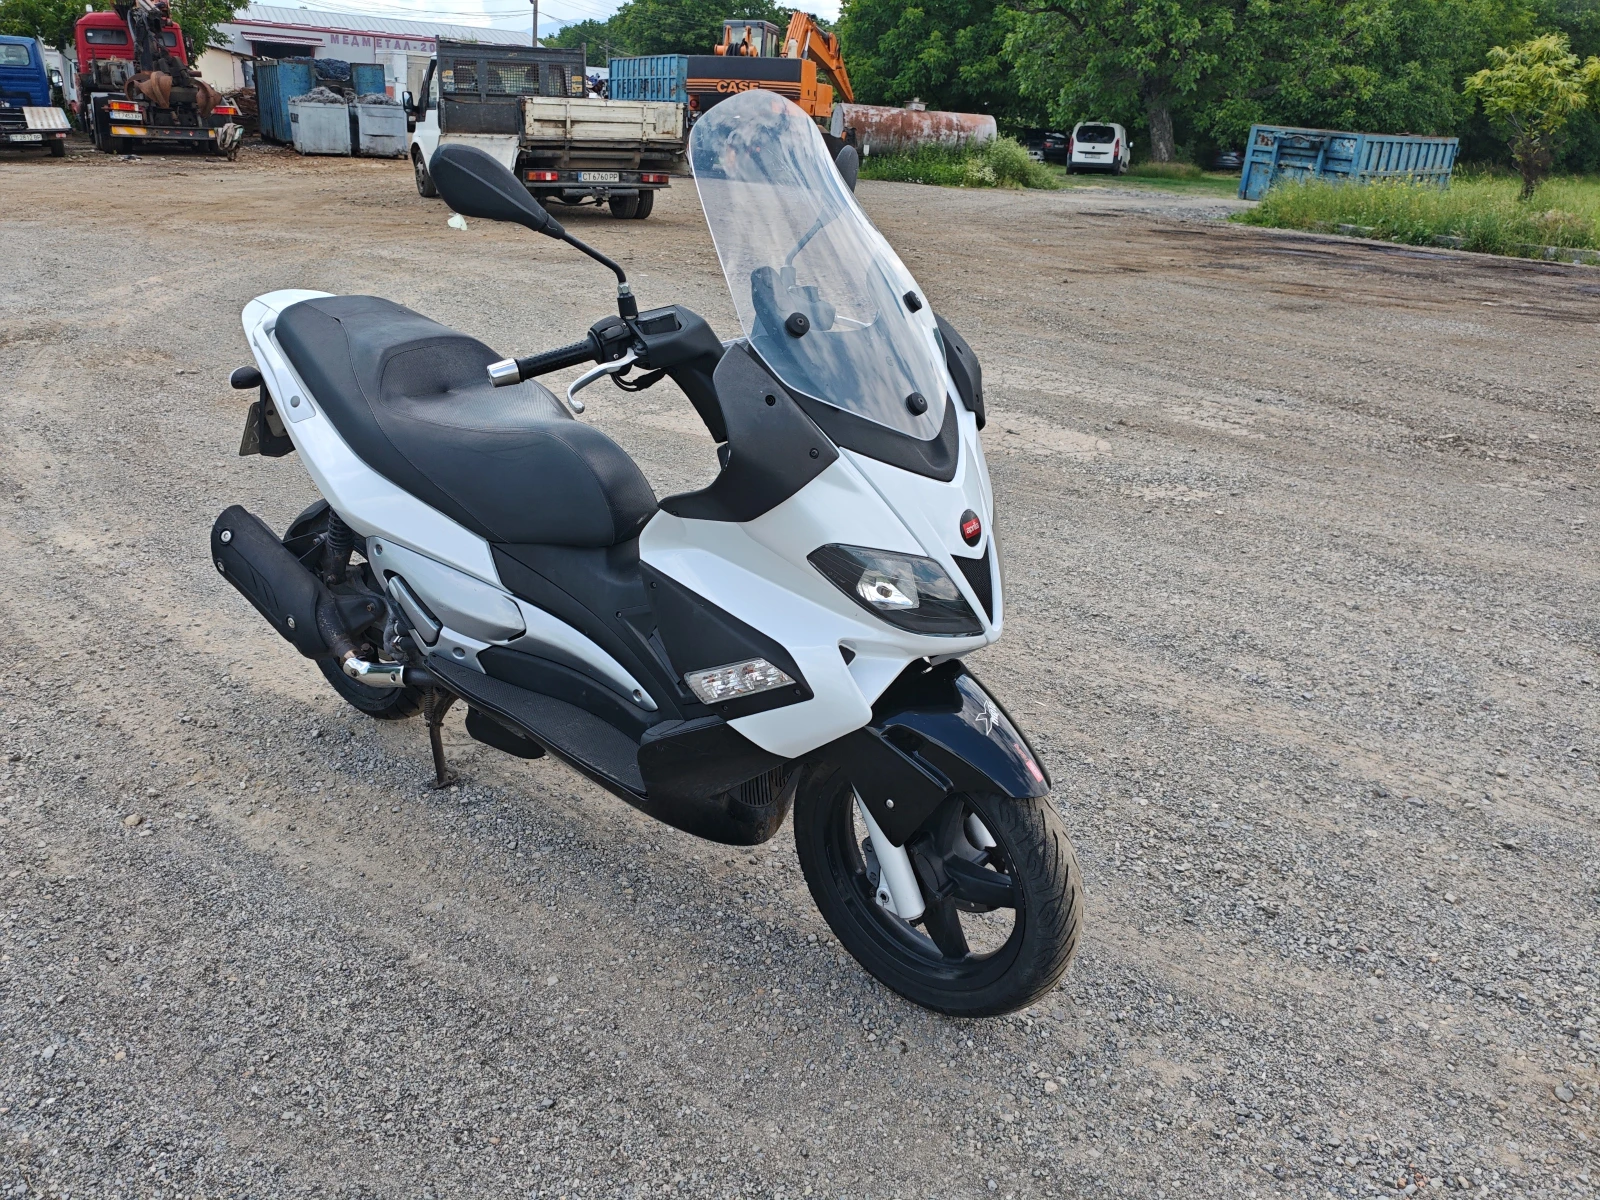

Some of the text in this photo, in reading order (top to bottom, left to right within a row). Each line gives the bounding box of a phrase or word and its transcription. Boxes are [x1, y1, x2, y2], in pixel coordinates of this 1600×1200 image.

[716, 80, 760, 93] CASE
[582, 172, 618, 181] CT 6760 PP
